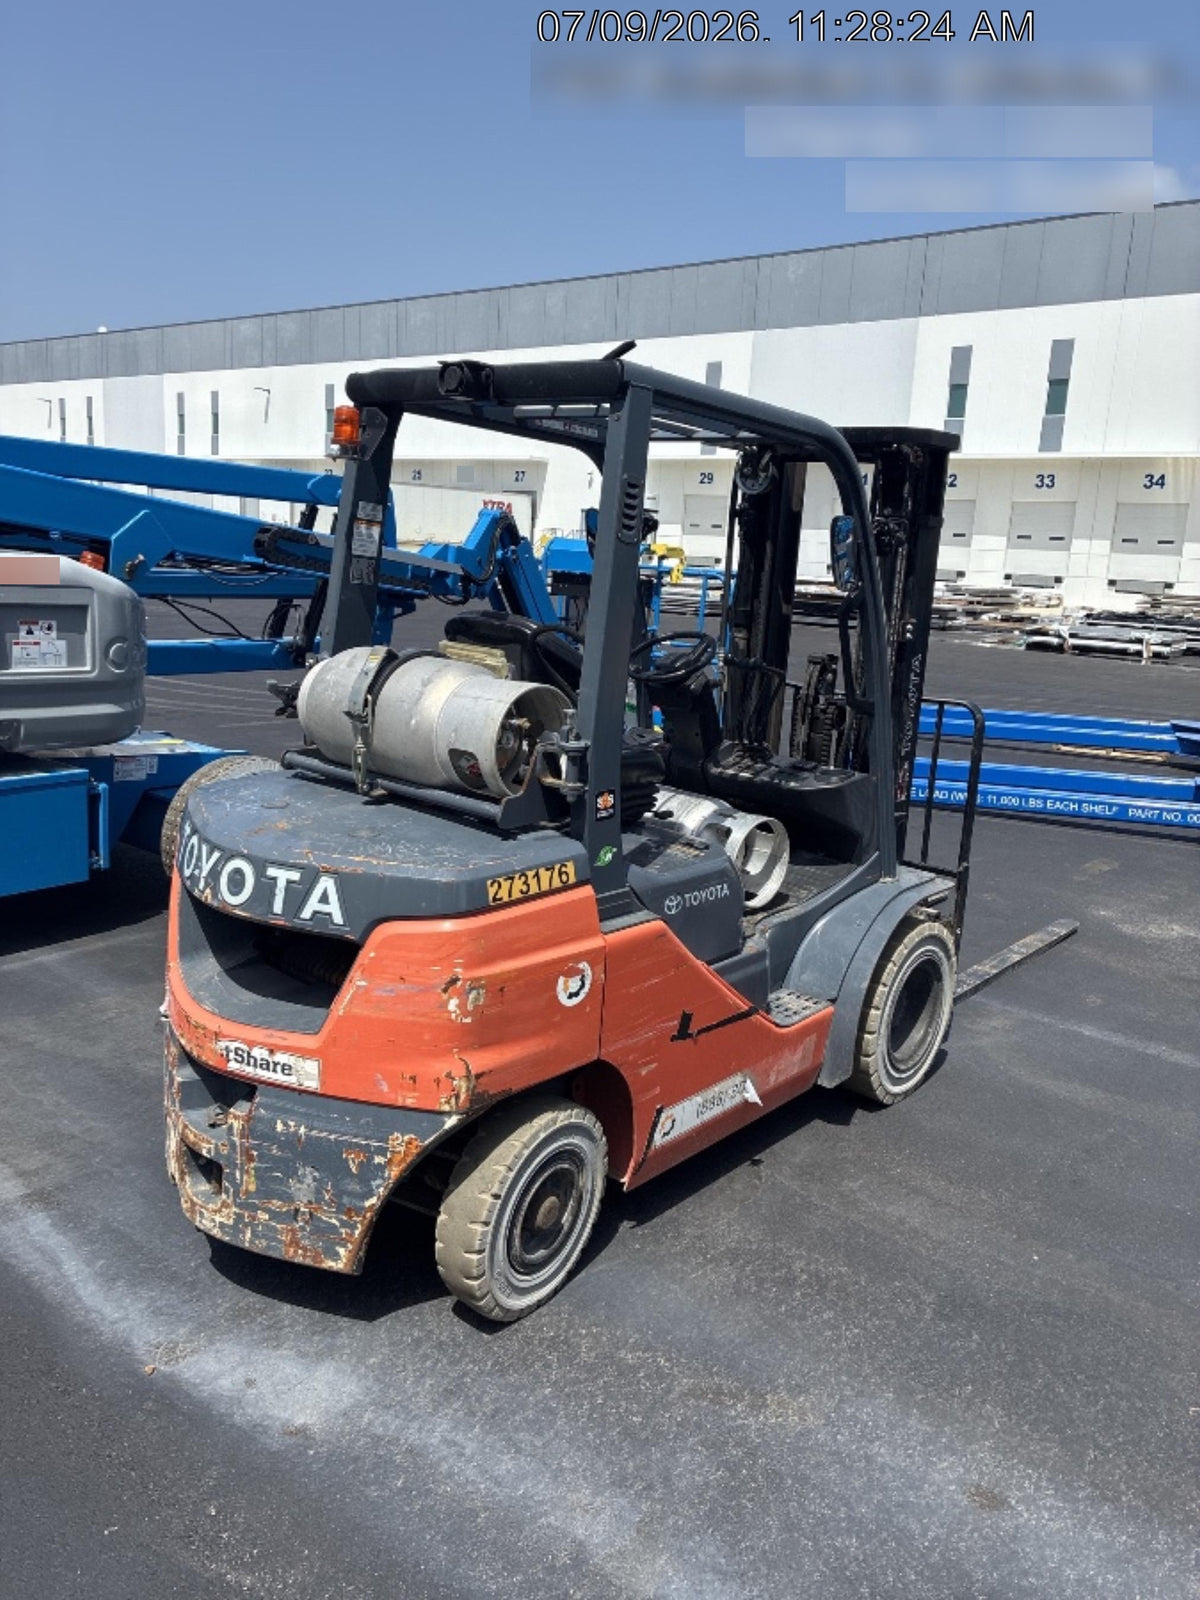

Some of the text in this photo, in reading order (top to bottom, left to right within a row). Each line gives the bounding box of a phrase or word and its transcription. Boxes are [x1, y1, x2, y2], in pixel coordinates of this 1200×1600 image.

[514, 470, 526, 482] 27
[699, 472, 714, 484] 29
[946, 474, 958, 488] 2
[1035, 474, 1056, 489] 33
[1143, 473, 1166, 489] 34
[1022, 797, 1043, 808] LBS
[1046, 799, 1078, 811] EACH
[1081, 802, 1119, 815] SHELF
[1128, 808, 1160, 819] PART
[1162, 812, 1184, 822] NO.
[490, 863, 571, 904] 273176
[684, 883, 730, 908] TOYOTA
